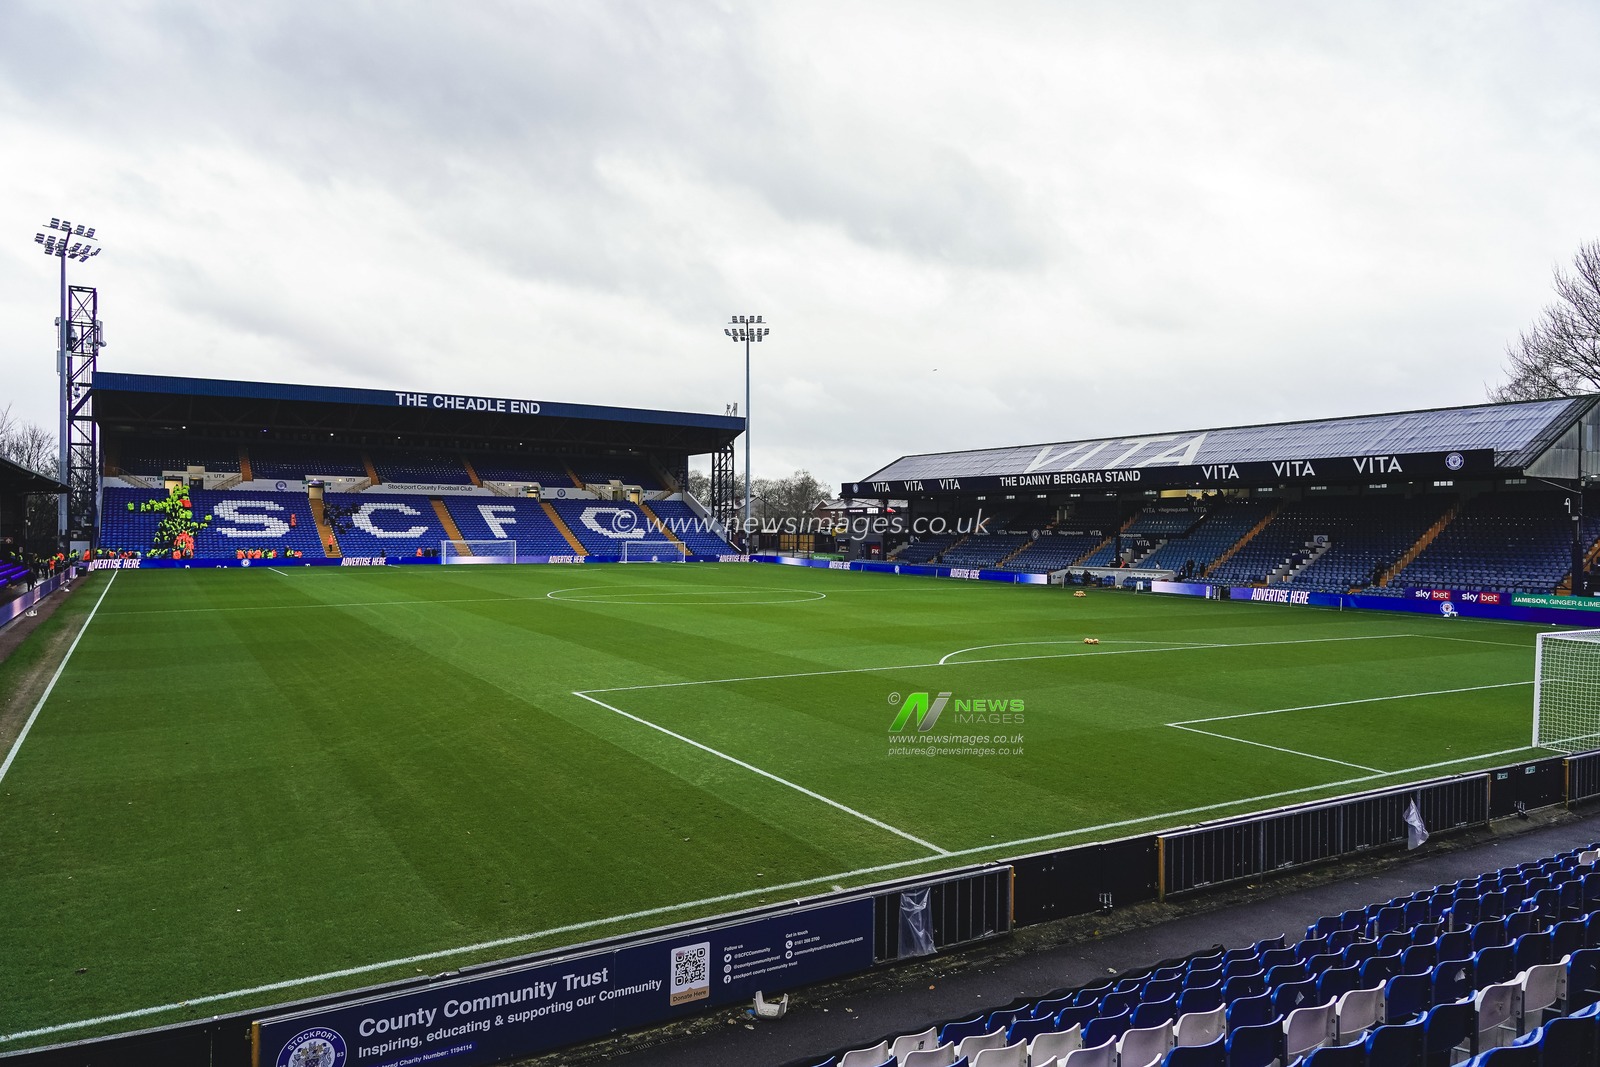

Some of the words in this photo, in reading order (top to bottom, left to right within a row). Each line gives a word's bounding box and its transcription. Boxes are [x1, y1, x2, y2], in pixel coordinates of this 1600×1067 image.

[395, 393, 427, 407] THE
[432, 395, 506, 412] CHEADLE
[510, 401, 540, 415] END
[1023, 432, 1207, 474] VITA
[1202, 465, 1239, 479] VITA
[1272, 461, 1315, 477] VITA
[1353, 456, 1403, 474] VITA
[904, 481, 924, 491] VITA
[939, 479, 961, 490] VITA
[1000, 477, 1017, 487] THE
[1019, 475, 1051, 486] DANNY
[1053, 472, 1102, 485] BERGARA
[1104, 470, 1141, 483] STAND
[872, 482, 891, 492] VITA
[214, 500, 290, 538] S
[352, 503, 429, 538] C
[477, 505, 517, 538] F
[579, 507, 646, 539] C
[122, 559, 141, 569] HERE
[341, 557, 371, 567] ADVERTISE
[371, 557, 387, 566] HERE
[1251, 588, 1290, 603] ADVERTISE
[1290, 590, 1310, 605] HERE
[1415, 589, 1431, 600] sky
[1433, 590, 1449, 599] bet
[1462, 592, 1478, 602] sky
[1481, 593, 1498, 602] bet
[1514, 597, 1548, 605] JAMESON,
[1549, 598, 1577, 606] GINGER
[359, 1007, 437, 1037] County
[444, 979, 559, 1018] Community
[562, 967, 609, 991] Trust
[672, 993, 693, 1002] Donate
[693, 990, 707, 998] Here
[358, 1033, 423, 1059] Inspiring,
[426, 1017, 491, 1042] educating
[495, 1015, 504, 1026] &
[507, 1001, 574, 1027] supporting
[576, 994, 596, 1007] our
[598, 978, 662, 1002] Community
[287, 1030, 338, 1051] STOCKPORT
[399, 1056, 422, 1067] Charity
[422, 1050, 449, 1061] Number:
